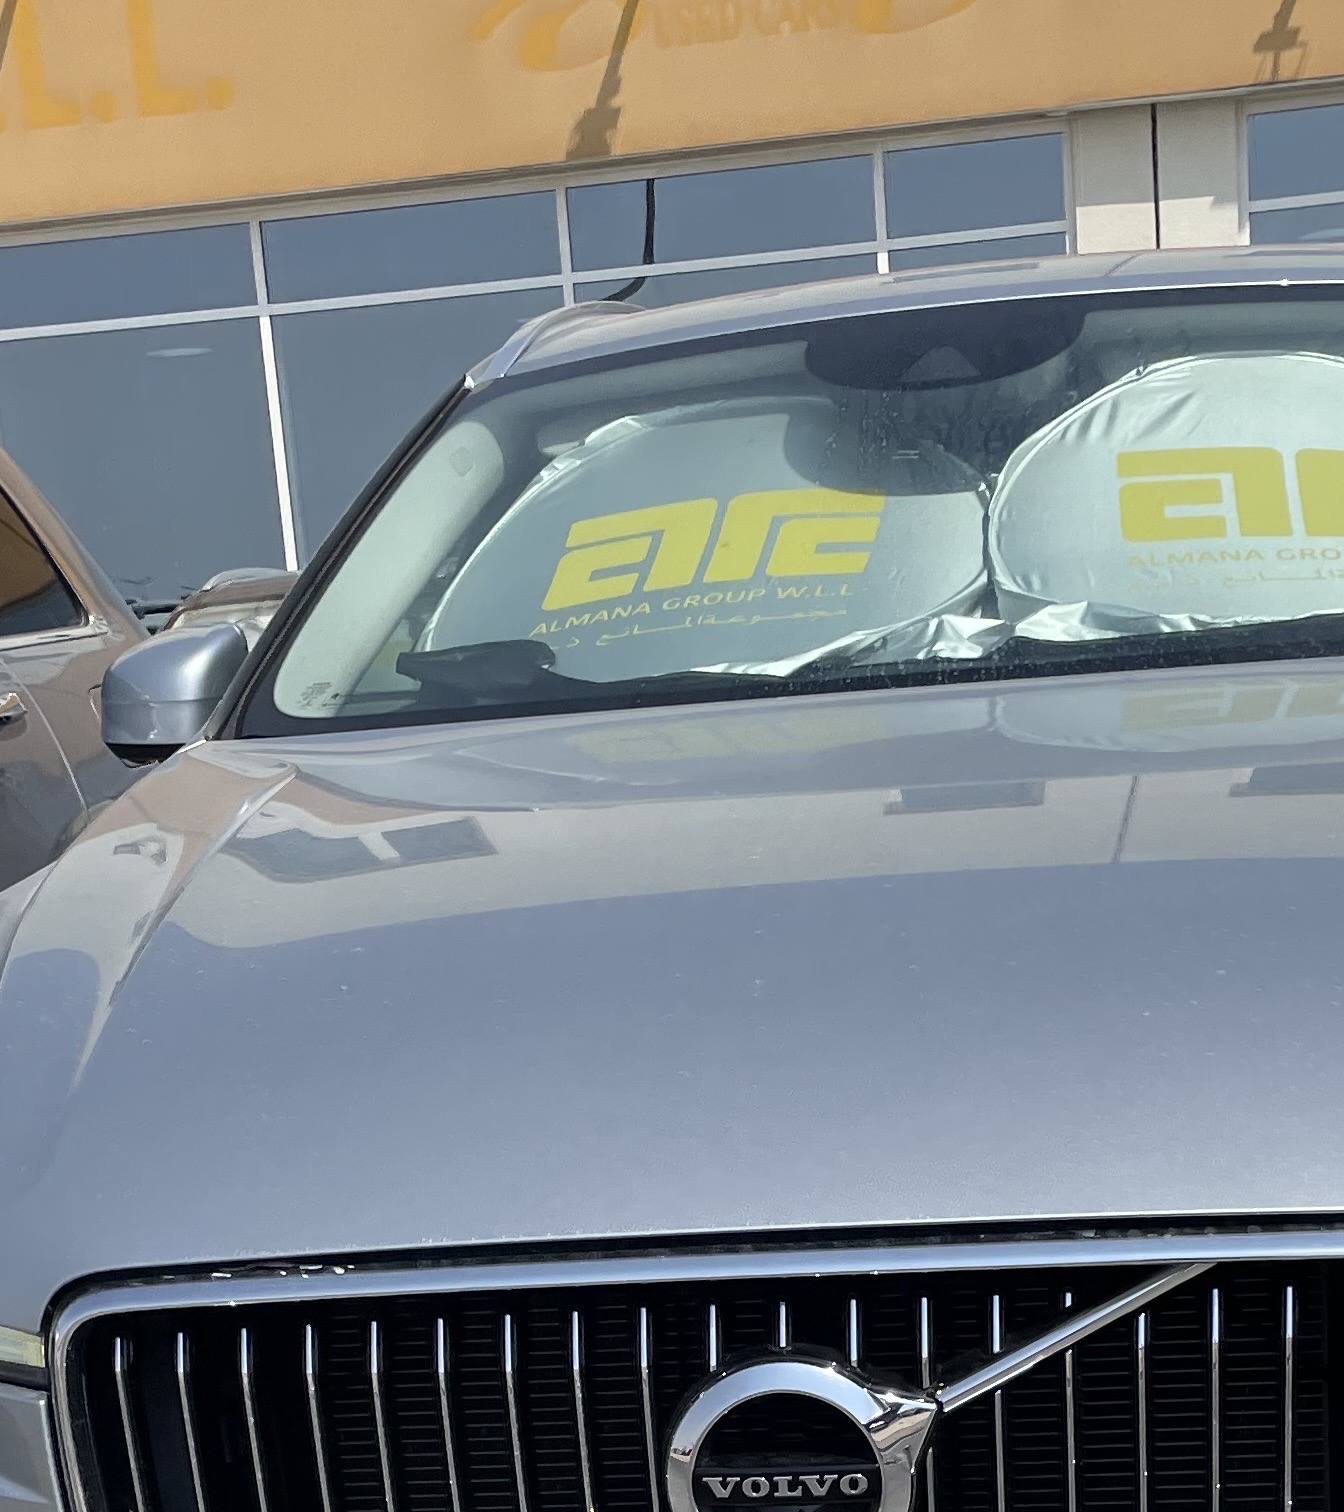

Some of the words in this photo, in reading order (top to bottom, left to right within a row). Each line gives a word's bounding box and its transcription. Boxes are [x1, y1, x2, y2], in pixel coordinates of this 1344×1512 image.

[1127, 549, 1265, 568] ALMANA
[526, 602, 651, 637] ALMANA
[661, 588, 766, 611] GROUP
[701, 1473, 869, 1499] VOLVO
